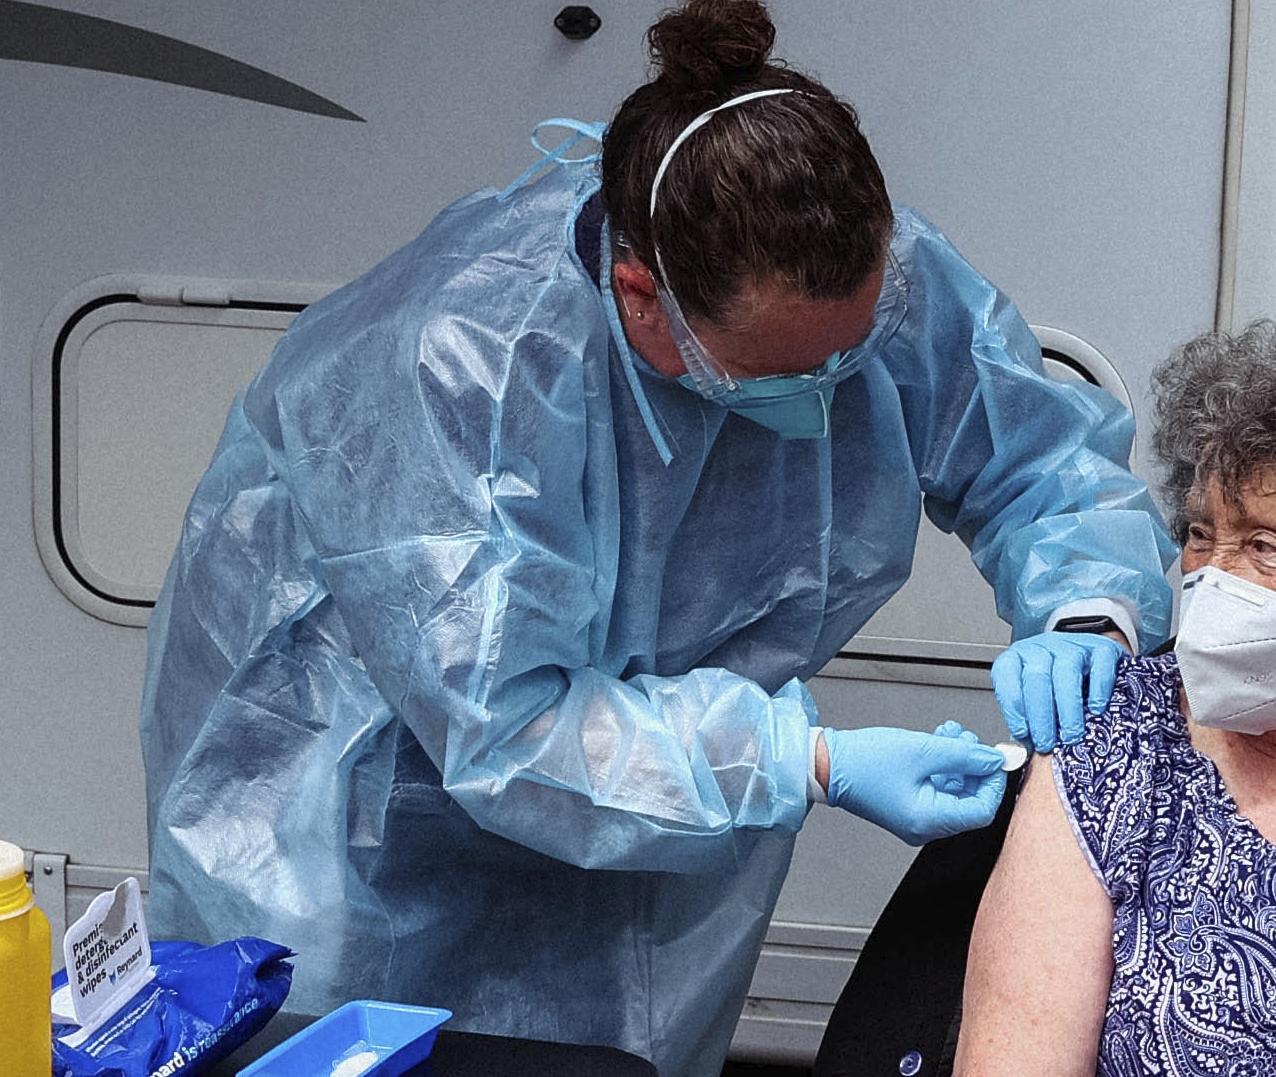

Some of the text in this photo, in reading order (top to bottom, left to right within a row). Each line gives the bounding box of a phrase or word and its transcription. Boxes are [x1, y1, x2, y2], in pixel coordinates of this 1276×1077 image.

[77, 971, 85, 985] &
[85, 921, 140, 978] disinfectant
[116, 945, 143, 976] Reynard
[79, 967, 108, 998] wipes
[182, 1046, 199, 1062] is
